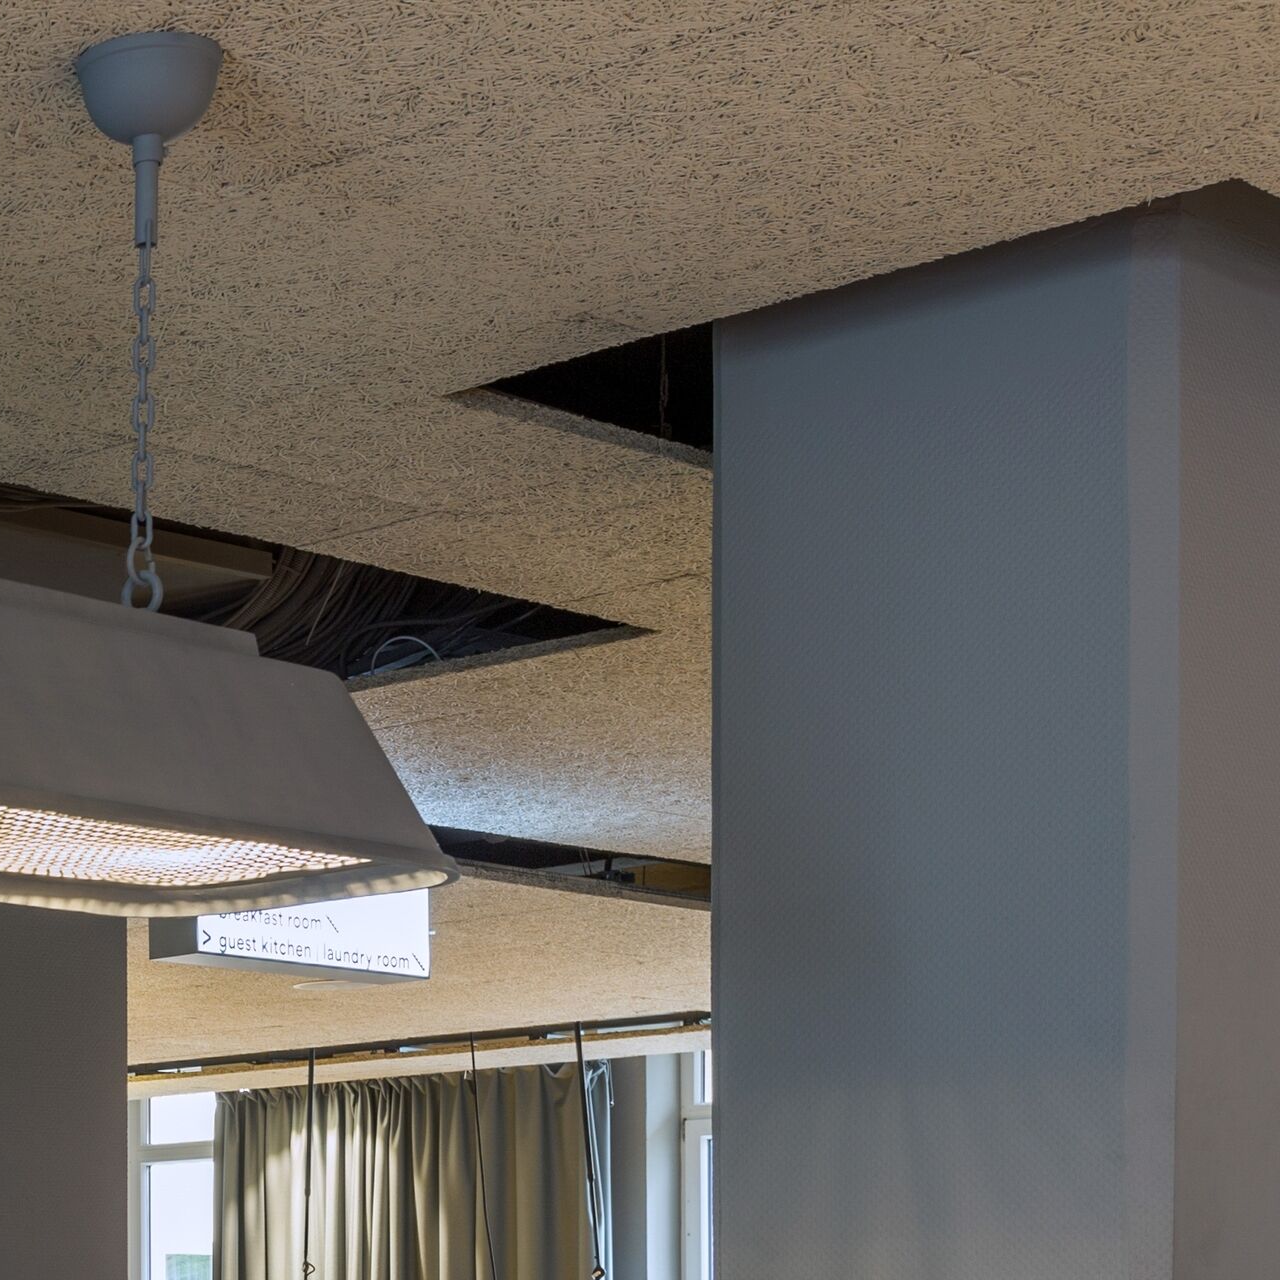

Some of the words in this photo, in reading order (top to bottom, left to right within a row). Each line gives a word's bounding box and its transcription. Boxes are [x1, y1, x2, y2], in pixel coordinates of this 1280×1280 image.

[288, 915, 321, 930] room
[220, 936, 256, 955] guest
[262, 936, 311, 957] kitchen
[324, 944, 371, 970] laundry
[377, 955, 410, 969] room
